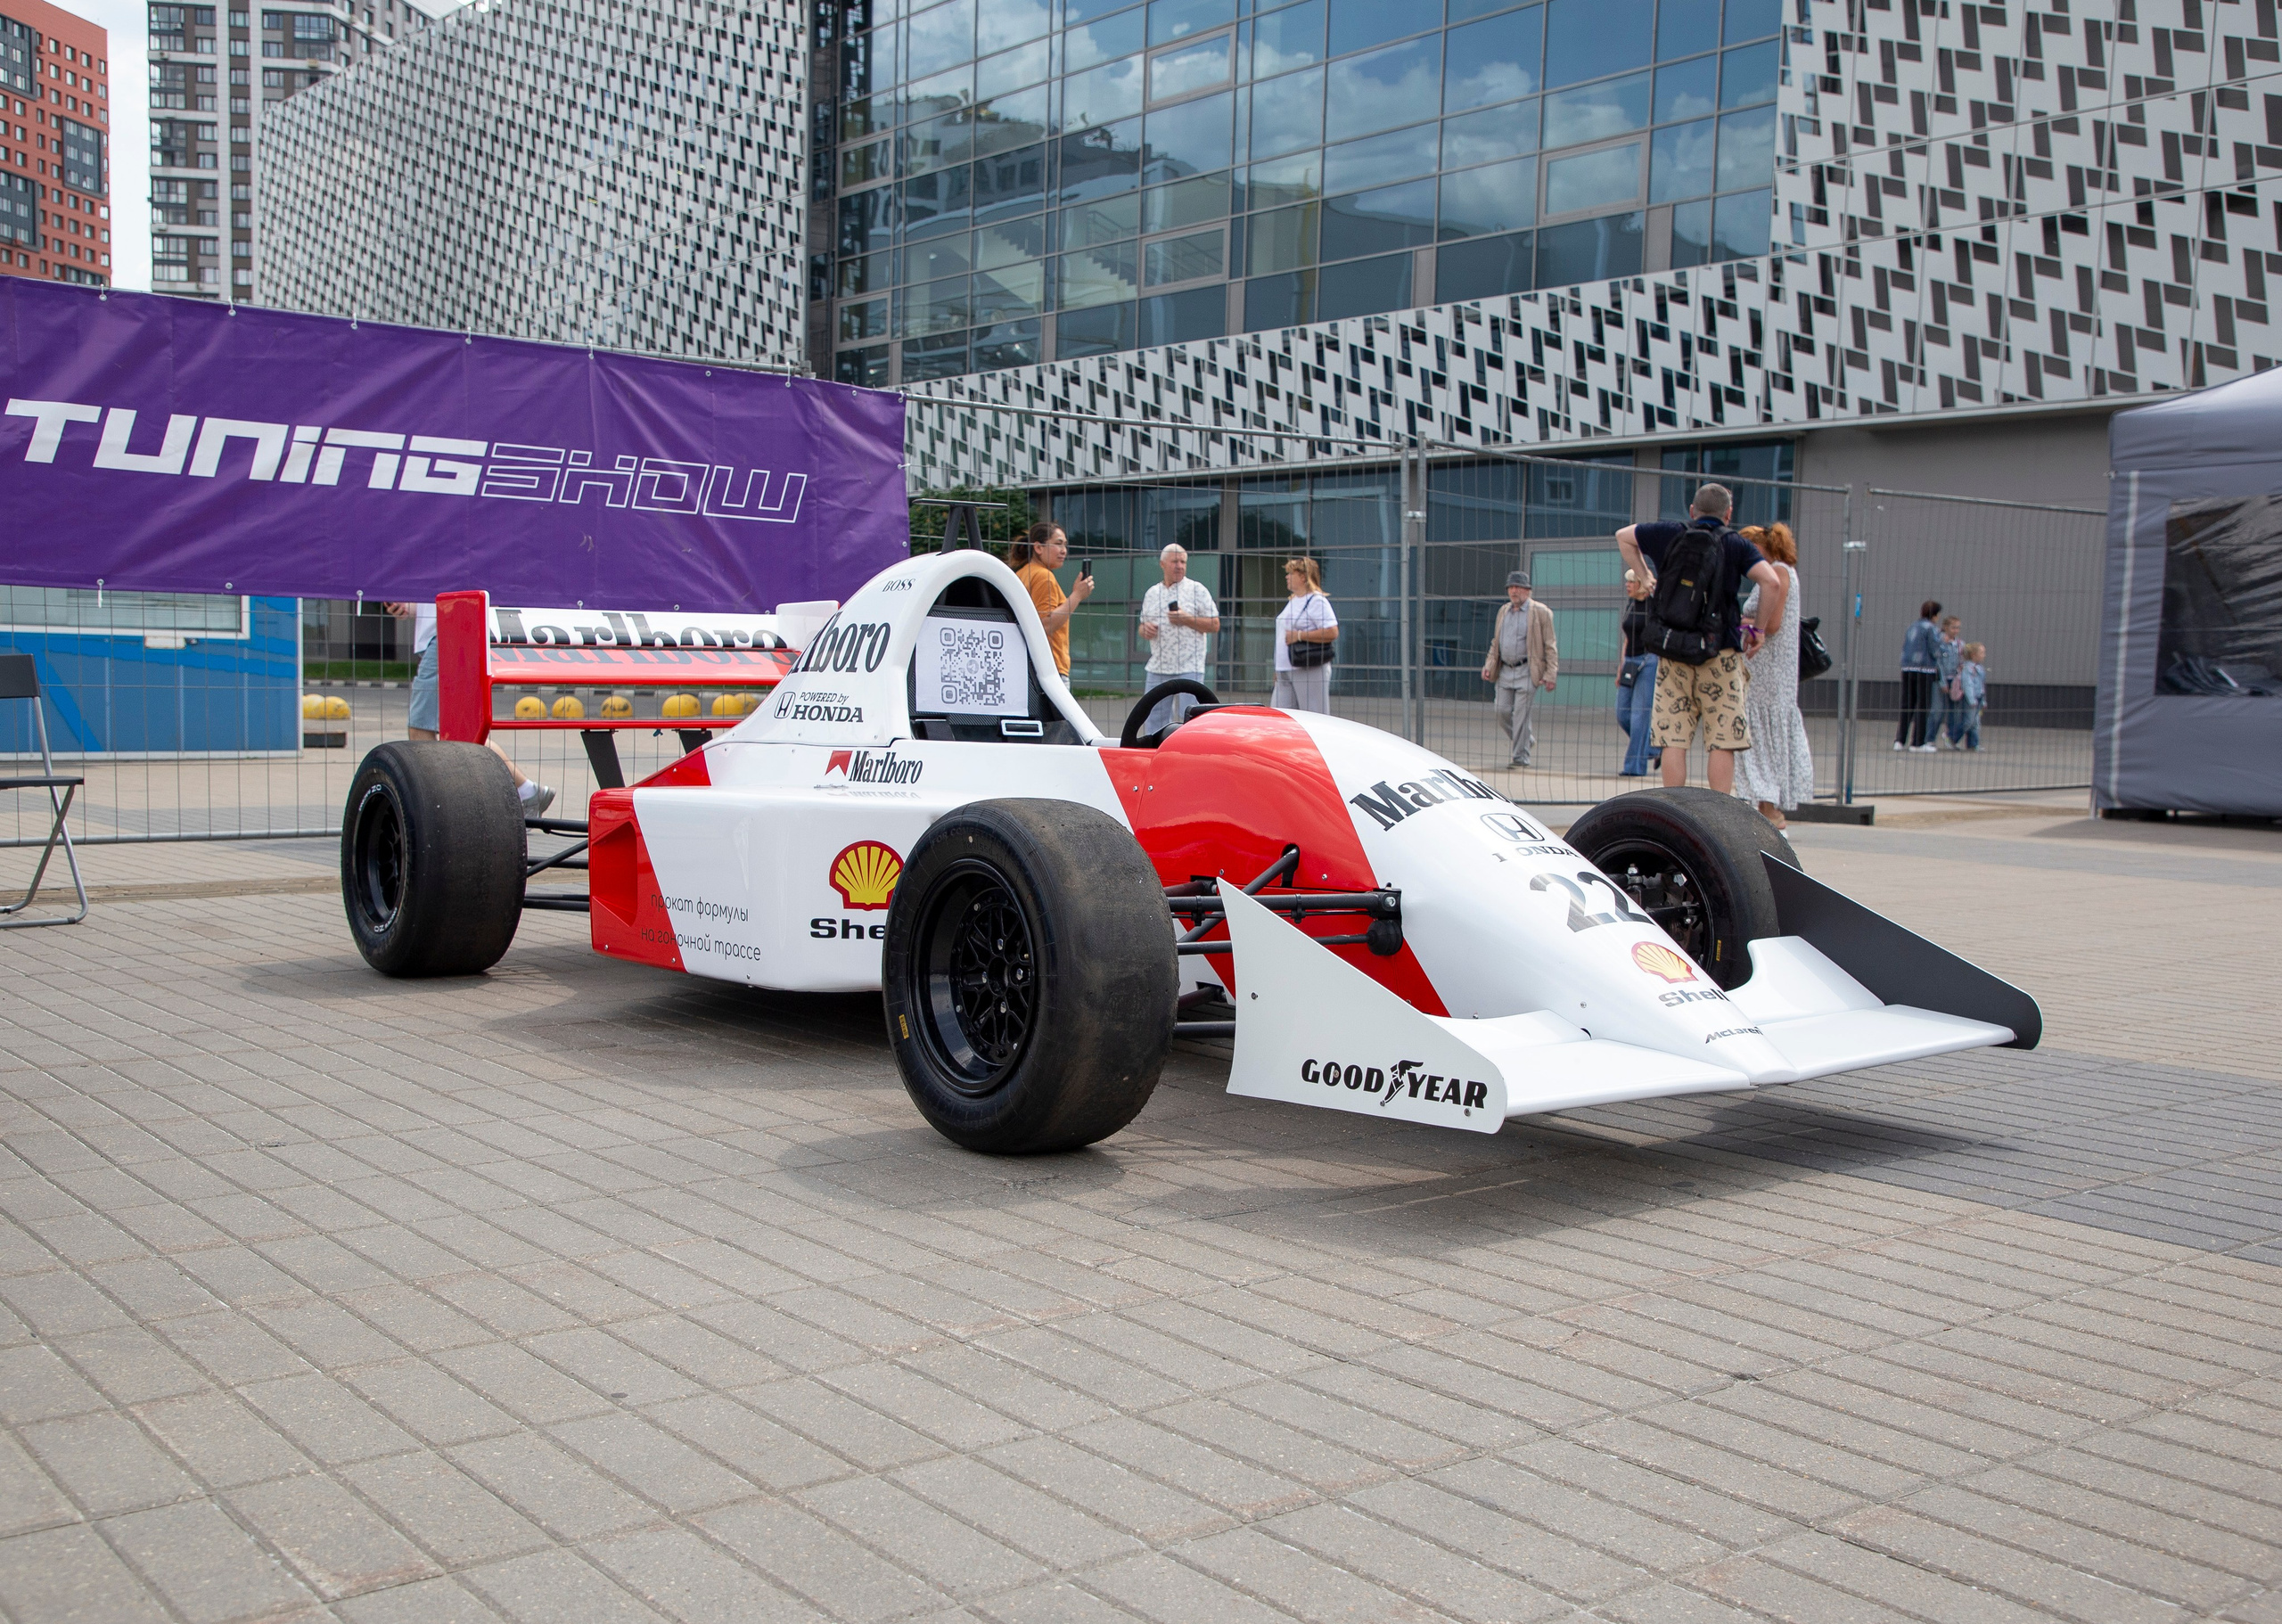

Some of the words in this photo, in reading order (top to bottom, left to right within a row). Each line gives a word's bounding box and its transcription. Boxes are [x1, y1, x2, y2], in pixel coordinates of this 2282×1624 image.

[882, 578, 915, 593] BOSS
[800, 692, 837, 702] POWERED
[837, 693, 850, 705] by
[791, 704, 864, 723] HONDA
[849, 750, 923, 785] Marlboro
[651, 894, 694, 912] прокат
[696, 897, 749, 924] формулы
[1530, 871, 1657, 933] 22
[809, 917, 886, 939] She
[641, 927, 654, 942] на
[657, 930, 710, 952] гоночной
[714, 939, 761, 961] трассе
[1658, 988, 1731, 1007] Shell
[1705, 1026, 1763, 1044] McLaren
